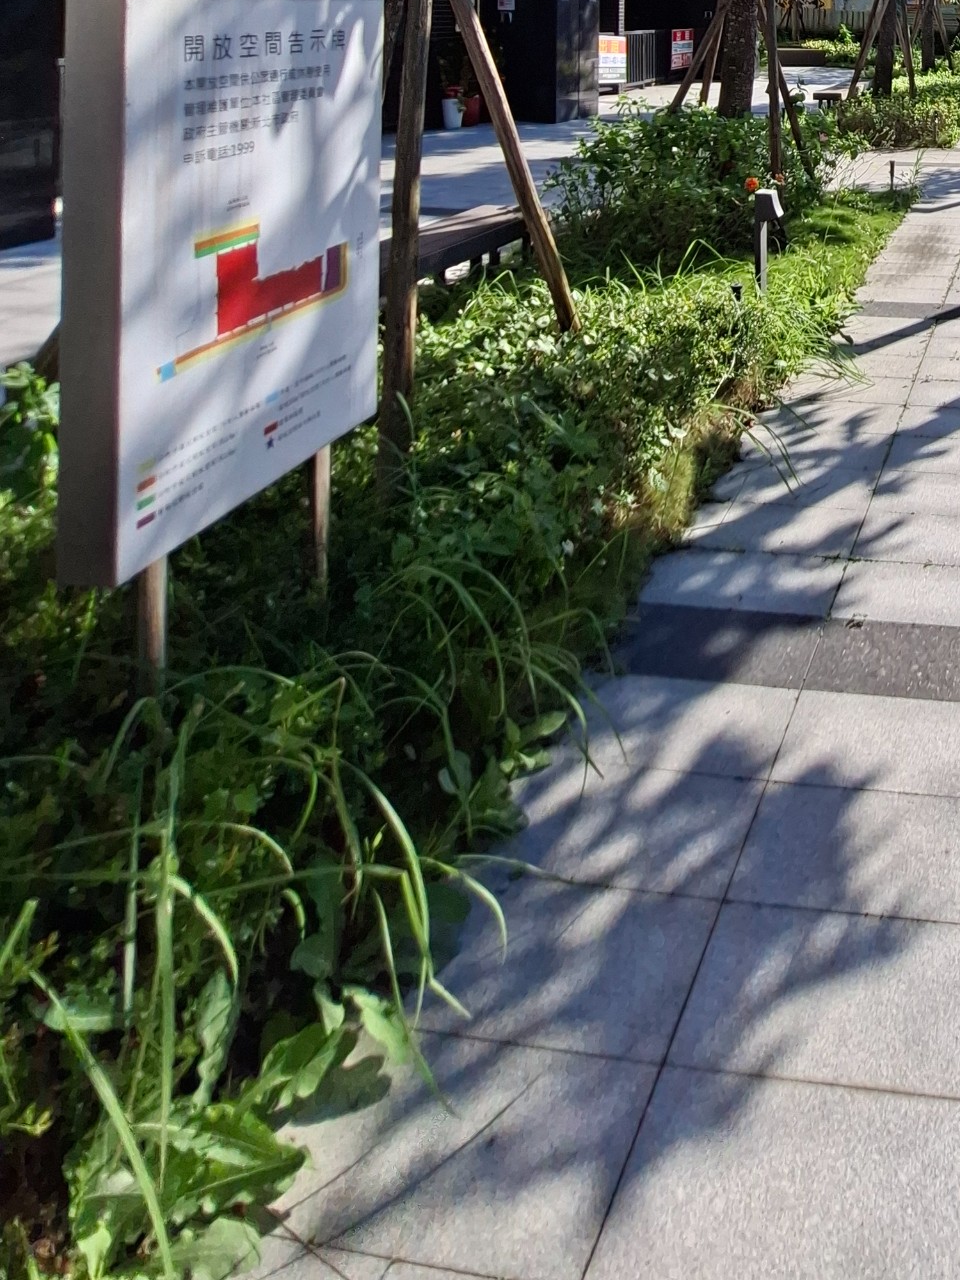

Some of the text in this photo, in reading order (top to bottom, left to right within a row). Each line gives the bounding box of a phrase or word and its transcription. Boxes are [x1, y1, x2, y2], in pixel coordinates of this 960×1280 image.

[184, 29, 346, 62] 開放空間告示牌
